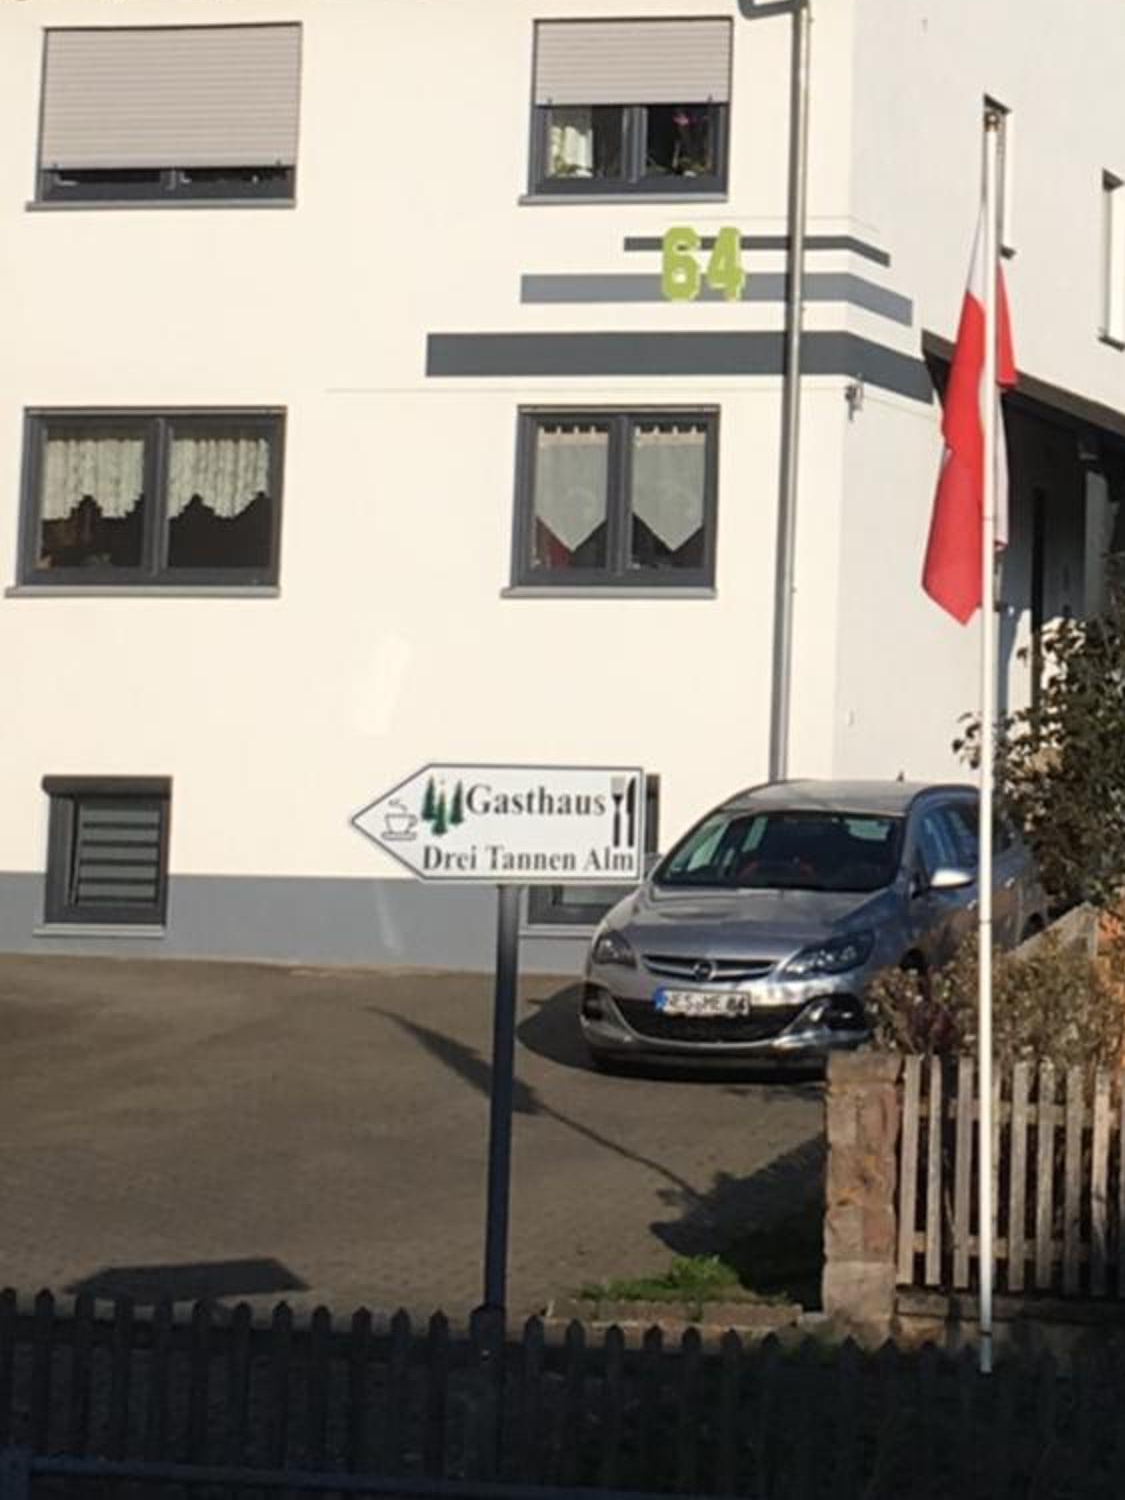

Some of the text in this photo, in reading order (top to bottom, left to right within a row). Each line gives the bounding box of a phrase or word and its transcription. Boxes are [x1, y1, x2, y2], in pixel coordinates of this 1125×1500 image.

[663, 226, 745, 302] 64
[467, 784, 606, 816] Gasthaus
[423, 845, 634, 871] Drei Tannen Alm
